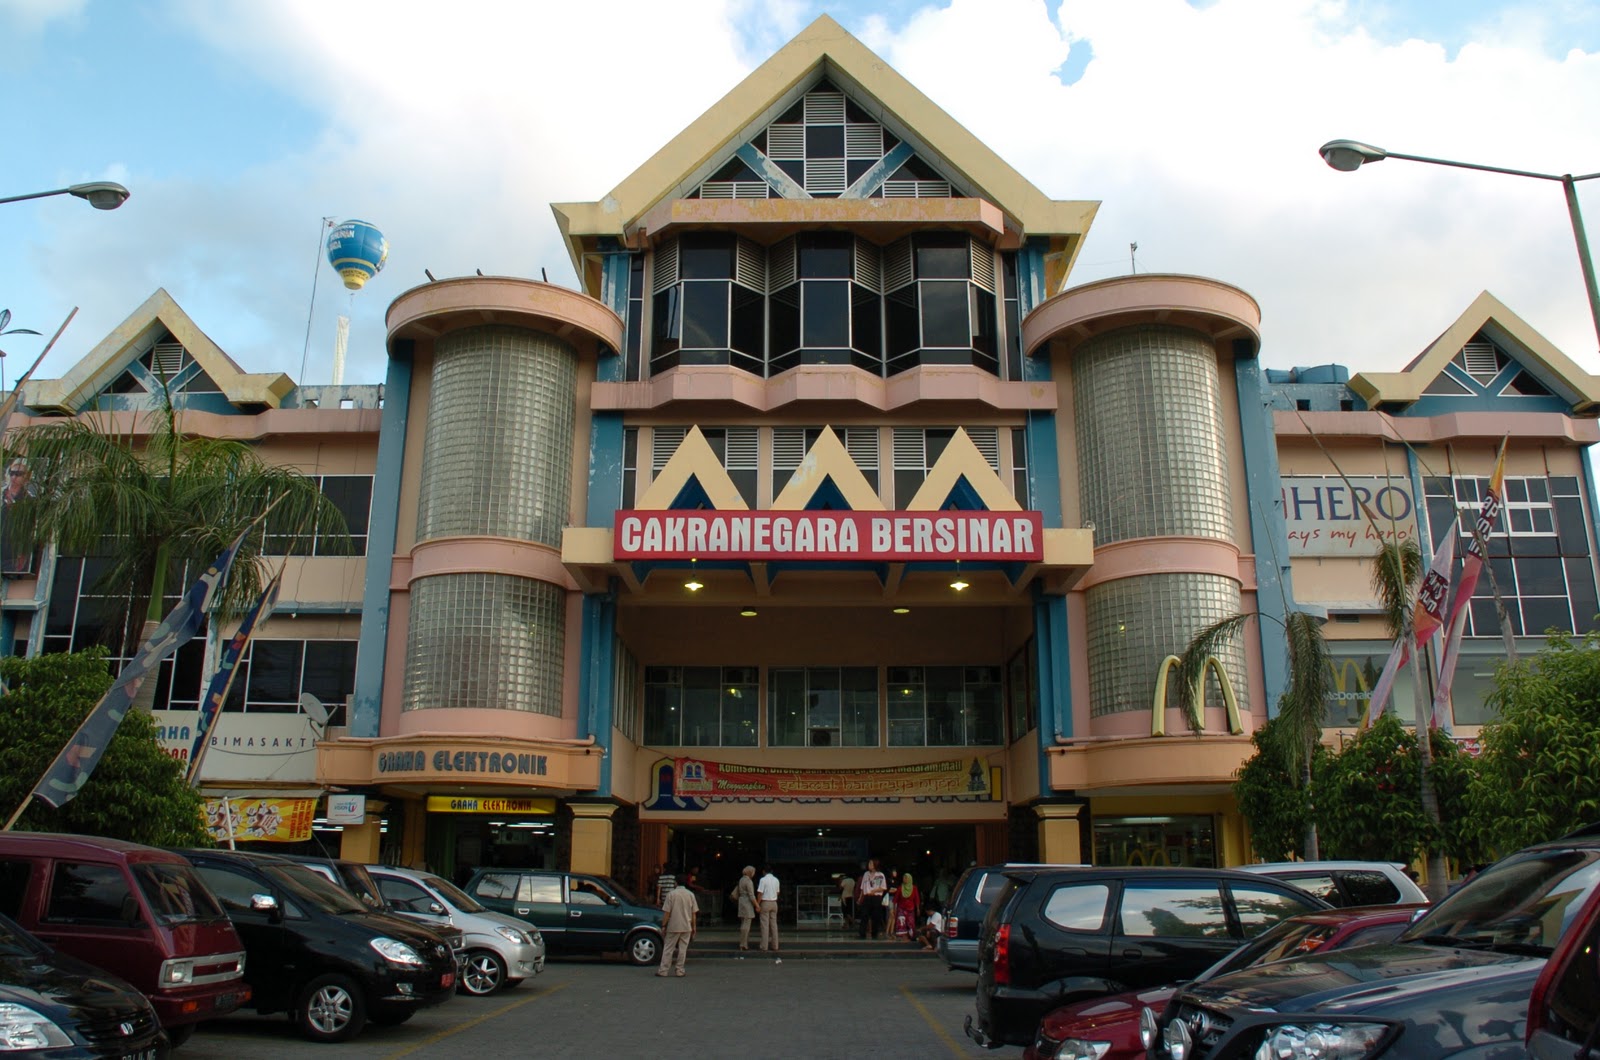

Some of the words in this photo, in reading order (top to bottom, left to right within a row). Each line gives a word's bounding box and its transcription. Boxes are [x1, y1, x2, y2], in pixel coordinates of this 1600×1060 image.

[1291, 486, 1412, 521] HERO
[621, 517, 859, 553] CAKRANEGARA
[871, 517, 1035, 553] BERSINAR
[1288, 529, 1321, 548] ays
[1330, 529, 1357, 548] my
[155, 725, 190, 740] AHA
[378, 750, 426, 773] GRAHA
[432, 750, 548, 776] ELEKTRONIK
[450, 800, 479, 811] GRAHA
[483, 800, 533, 812] ELEKTRONIK
